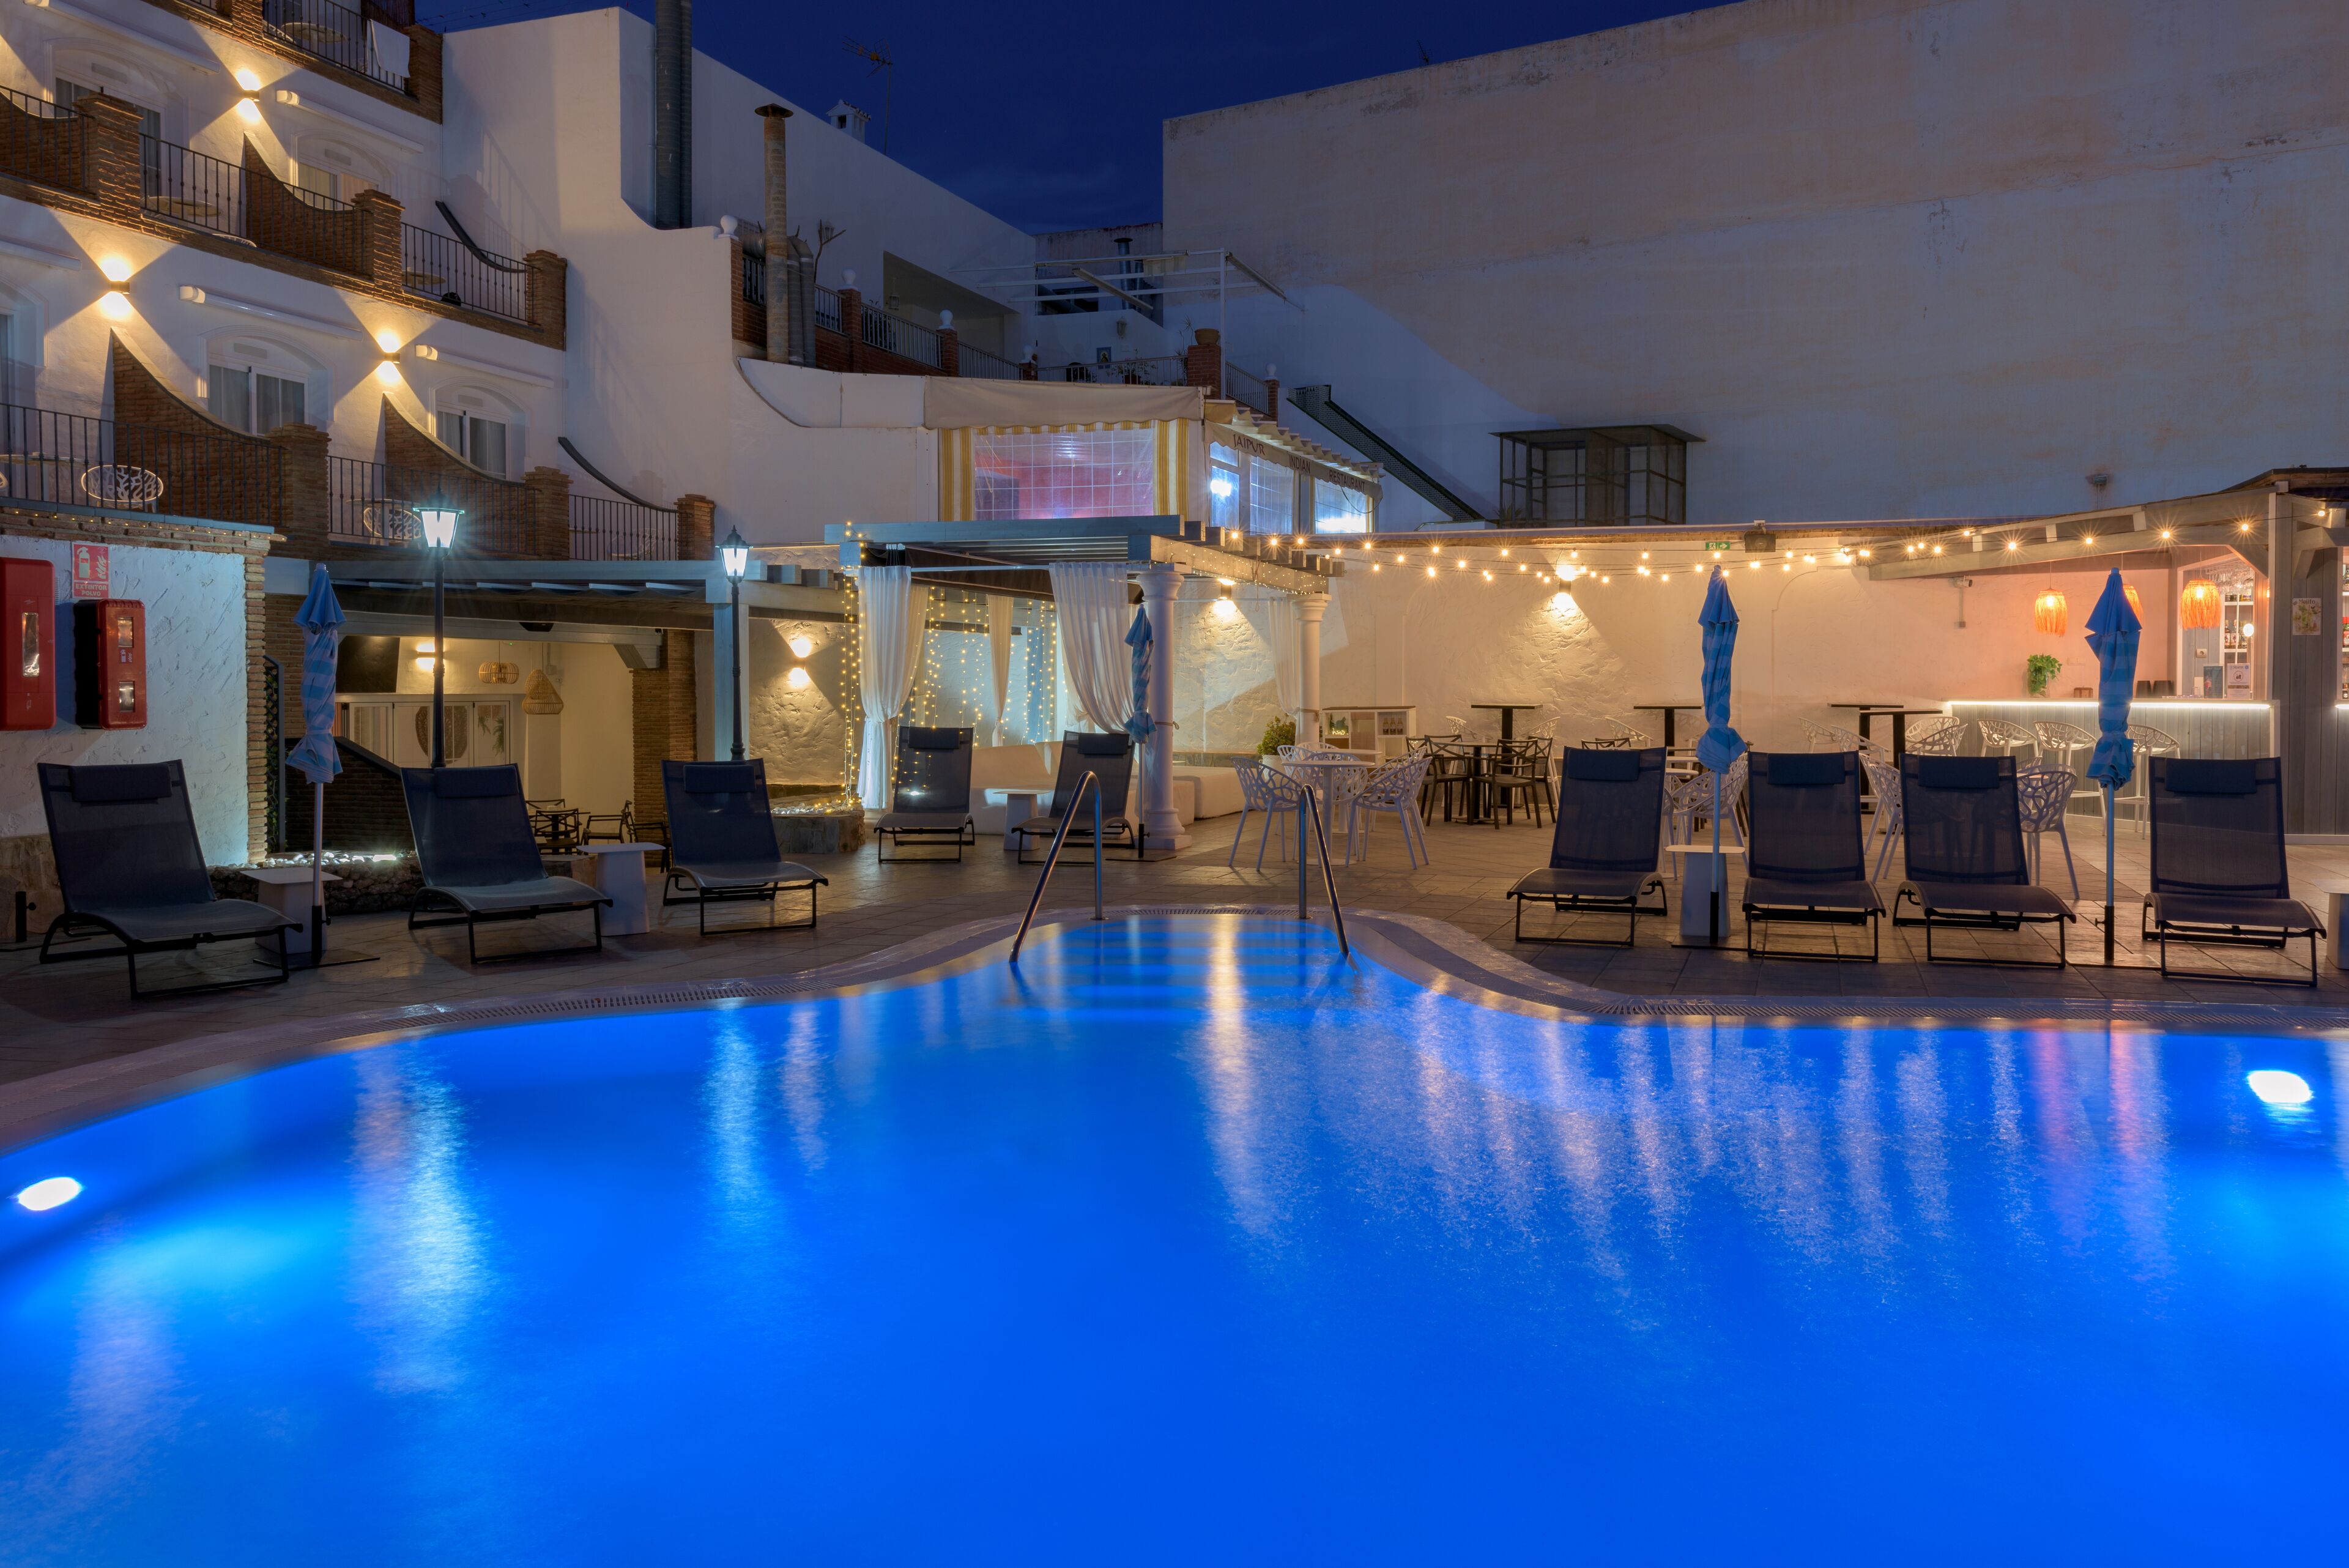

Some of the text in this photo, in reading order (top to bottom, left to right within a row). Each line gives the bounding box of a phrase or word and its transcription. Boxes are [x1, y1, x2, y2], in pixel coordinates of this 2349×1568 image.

[1233, 434, 1365, 492] JAIPUR INDIAN RESTAURANT
